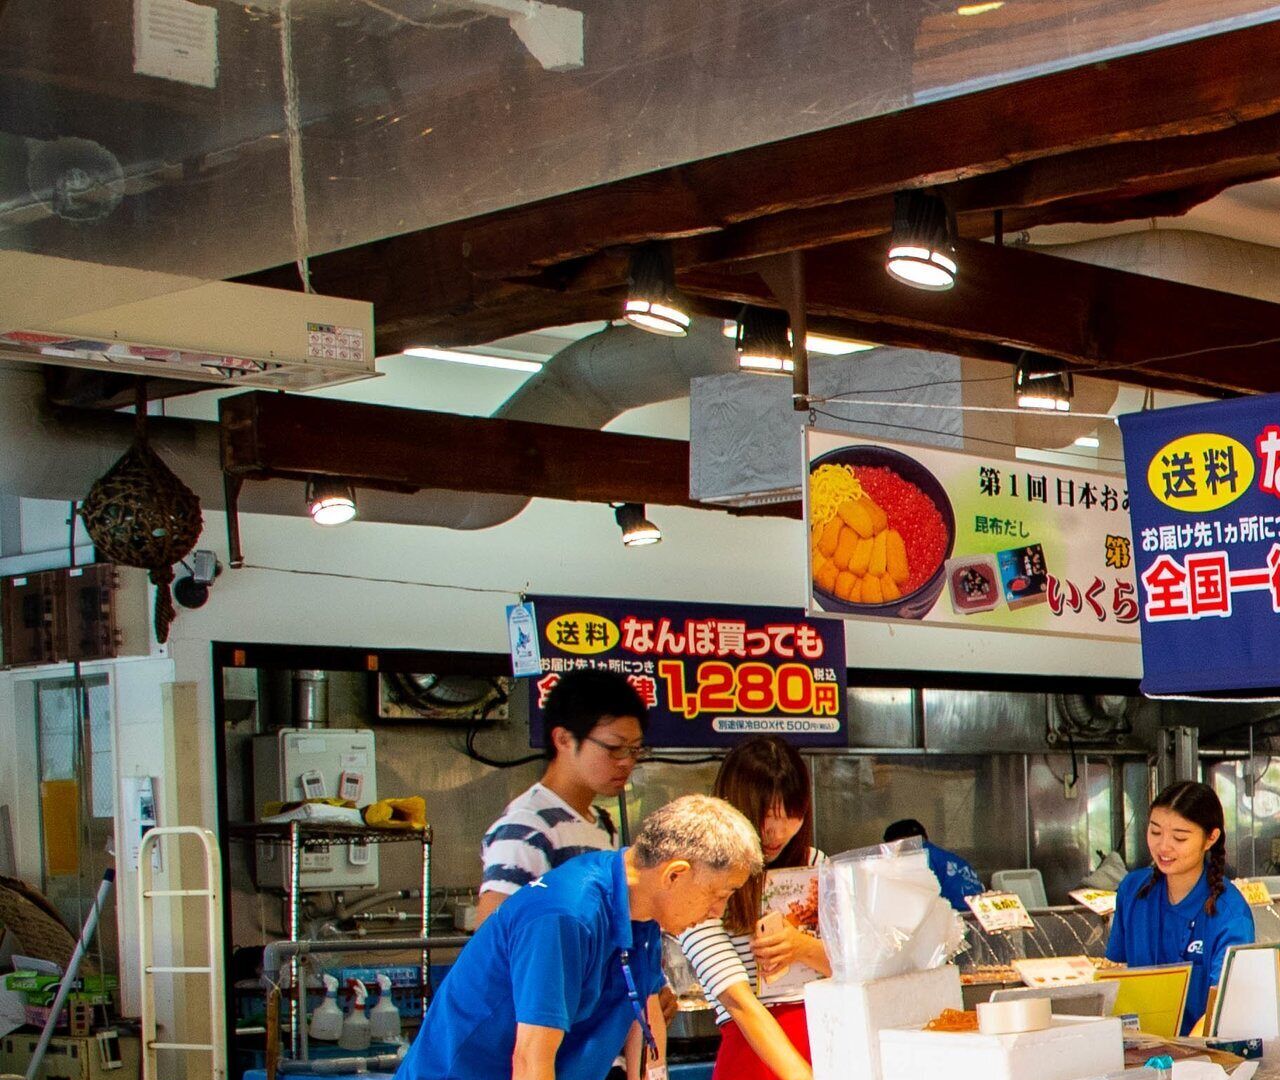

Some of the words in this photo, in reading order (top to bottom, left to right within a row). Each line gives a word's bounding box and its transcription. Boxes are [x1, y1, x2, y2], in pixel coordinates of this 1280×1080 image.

[979, 466, 1048, 504] 第1回
[1162, 448, 1240, 500] 送料
[975, 515, 1031, 539] 昆布だし
[1046, 573, 1140, 625] いくら
[556, 620, 610, 647] 送料
[623, 618, 824, 657] なんぼ買っても
[813, 668, 838, 682] 税込
